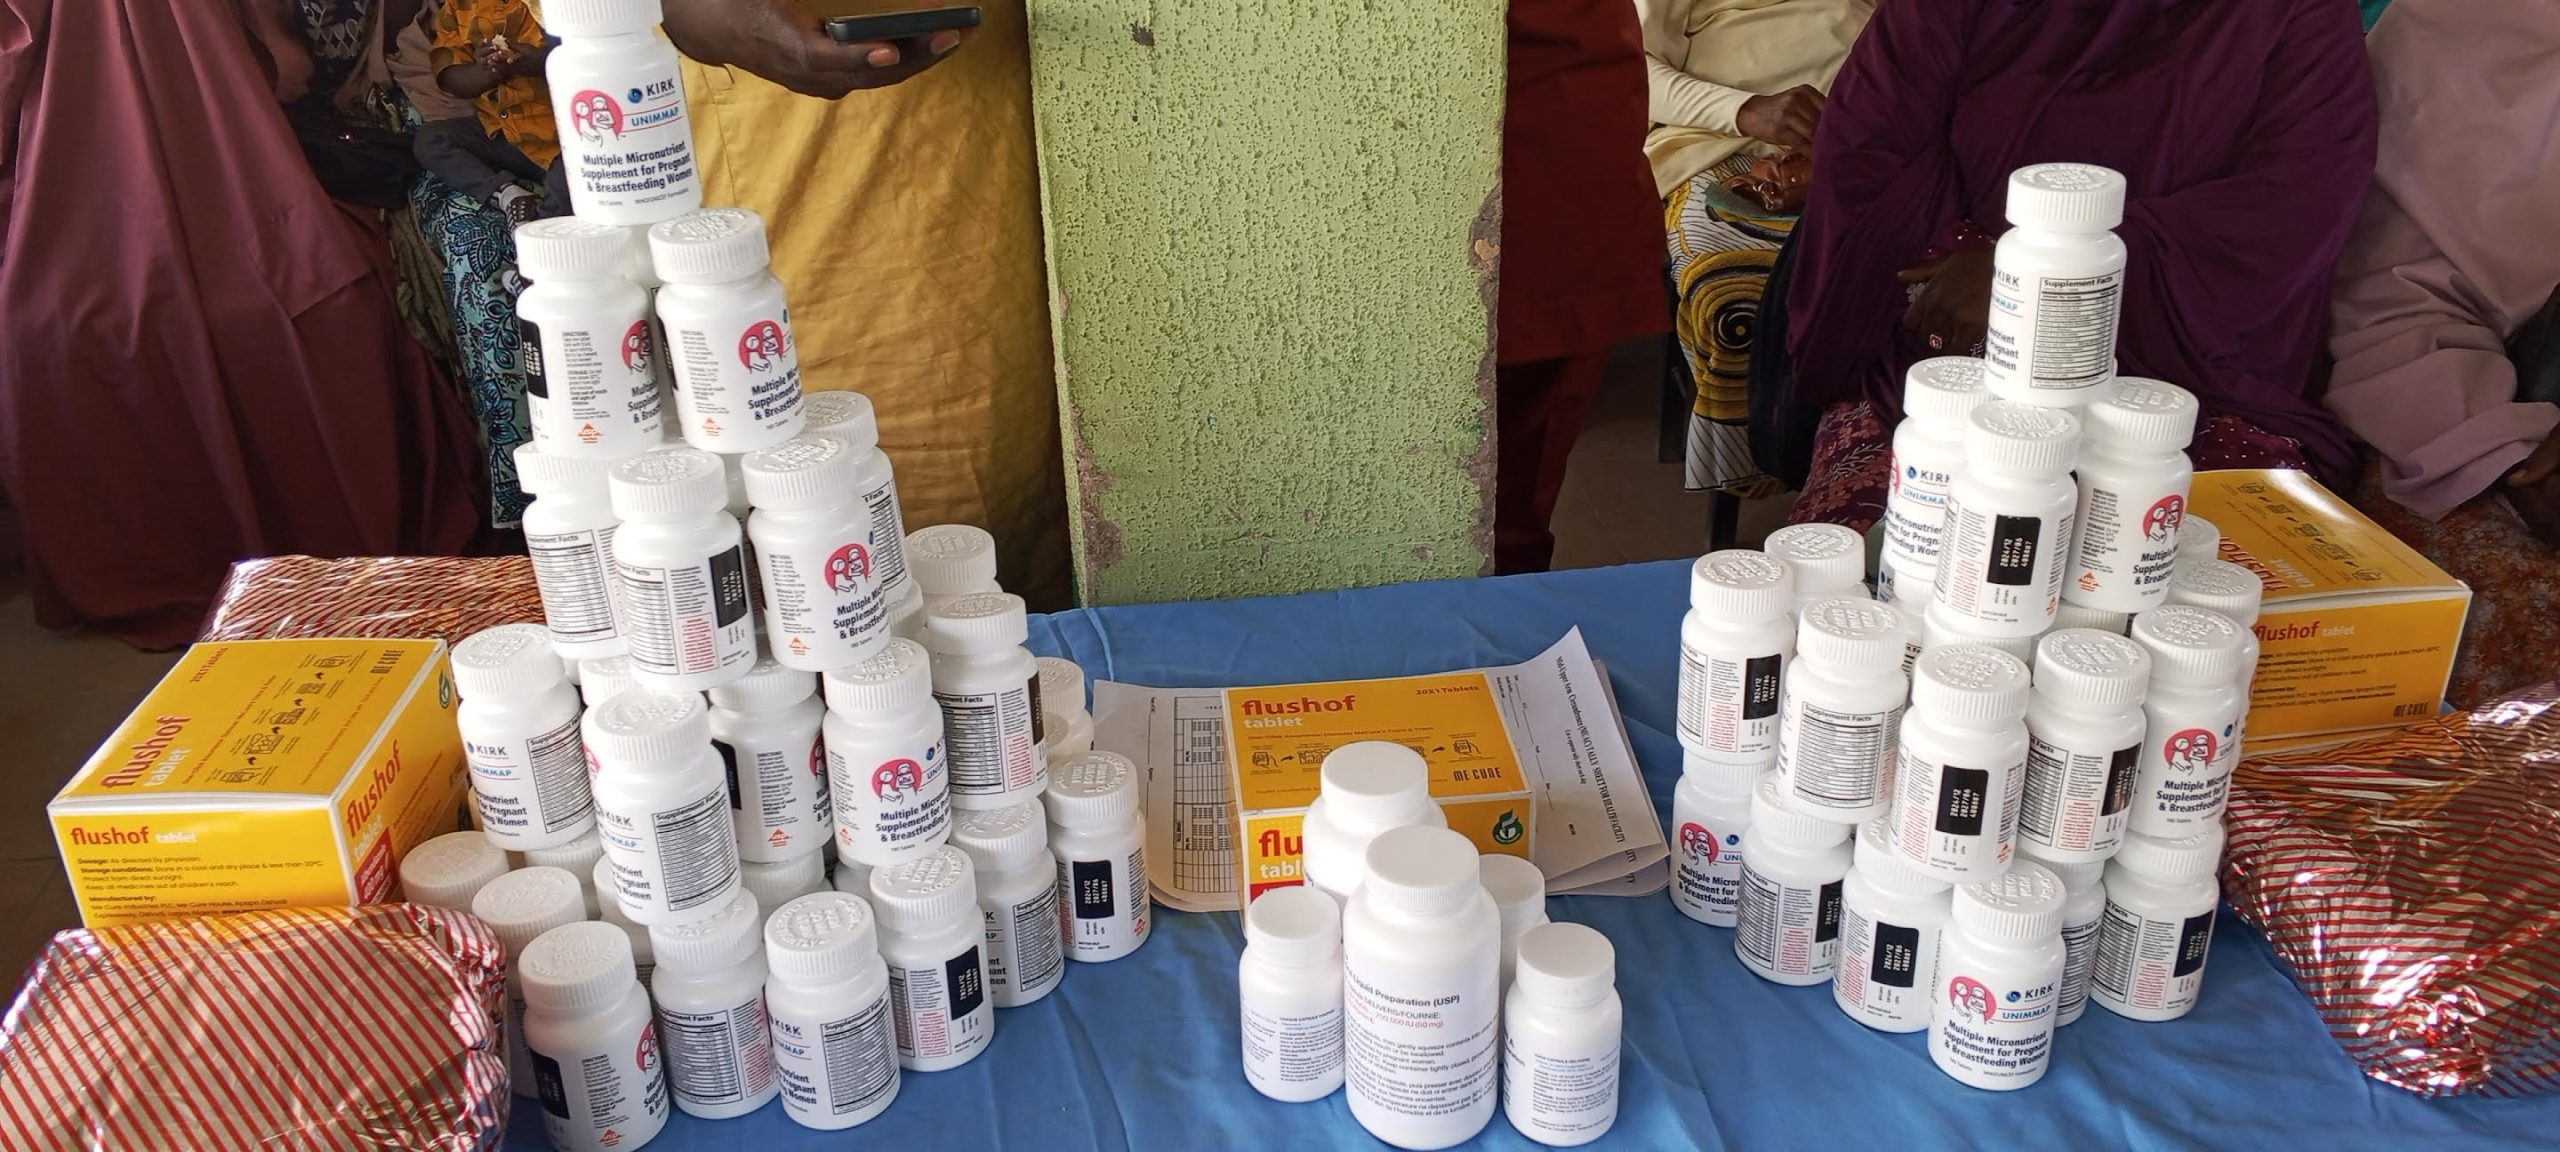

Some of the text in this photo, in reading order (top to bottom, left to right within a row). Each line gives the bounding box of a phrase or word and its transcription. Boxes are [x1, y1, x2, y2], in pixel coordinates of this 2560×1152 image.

[646, 78, 675, 97] KIRK
[631, 107, 679, 127] UNIMMAP
[583, 140, 686, 168] Multiple Micronutrient
[581, 153, 691, 181] Supplement for Pregnant
[595, 176, 666, 193] Breastfeeding
[667, 168, 692, 184] Women
[2044, 279, 2096, 289] Supplement
[751, 376, 786, 396] Multiple
[748, 383, 796, 410] Supplement
[755, 411, 762, 421] &
[1903, 488, 1946, 505] UNIMMA
[1912, 532, 1939, 546] Pregn
[2134, 577, 2141, 585] &
[837, 596, 871, 615] Multiple
[833, 603, 880, 629] Supplement
[839, 630, 847, 639] &
[2255, 620, 2320, 640] flushof
[1241, 694, 1356, 716] flushof
[1243, 716, 1304, 729] tablet
[101, 715, 192, 789] flushof
[476, 745, 507, 756] KIRK
[143, 747, 192, 788] tablet
[1453, 769, 1468, 782] ME
[346, 739, 400, 838] flushof
[2164, 779, 2205, 792] Multiple
[2156, 789, 2212, 803] Supplement
[489, 804, 527, 817] Pregnant
[880, 806, 919, 820] Multiple
[2158, 801, 2166, 811] &
[496, 816, 529, 826] Women
[876, 807, 940, 833] Supplement for
[71, 825, 198, 845] flushof tablet
[881, 834, 888, 842] &
[1260, 859, 1302, 879] tabl
[1680, 862, 1711, 883] Multiple
[1677, 870, 1735, 896] Supplement for
[1375, 989, 1430, 1007] Preparation
[1433, 994, 1460, 1008] (USP)
[2025, 982, 2055, 999] KIRK
[2002, 1004, 2051, 1020] UNIMMAP
[1943, 1027, 2049, 1057] Supplement for Pregnant
[1948, 1019, 2047, 1047] Multiple Micronutrient
[1944, 1039, 2046, 1069] & Breastfeeding Women
[787, 1089, 817, 1105] Women
